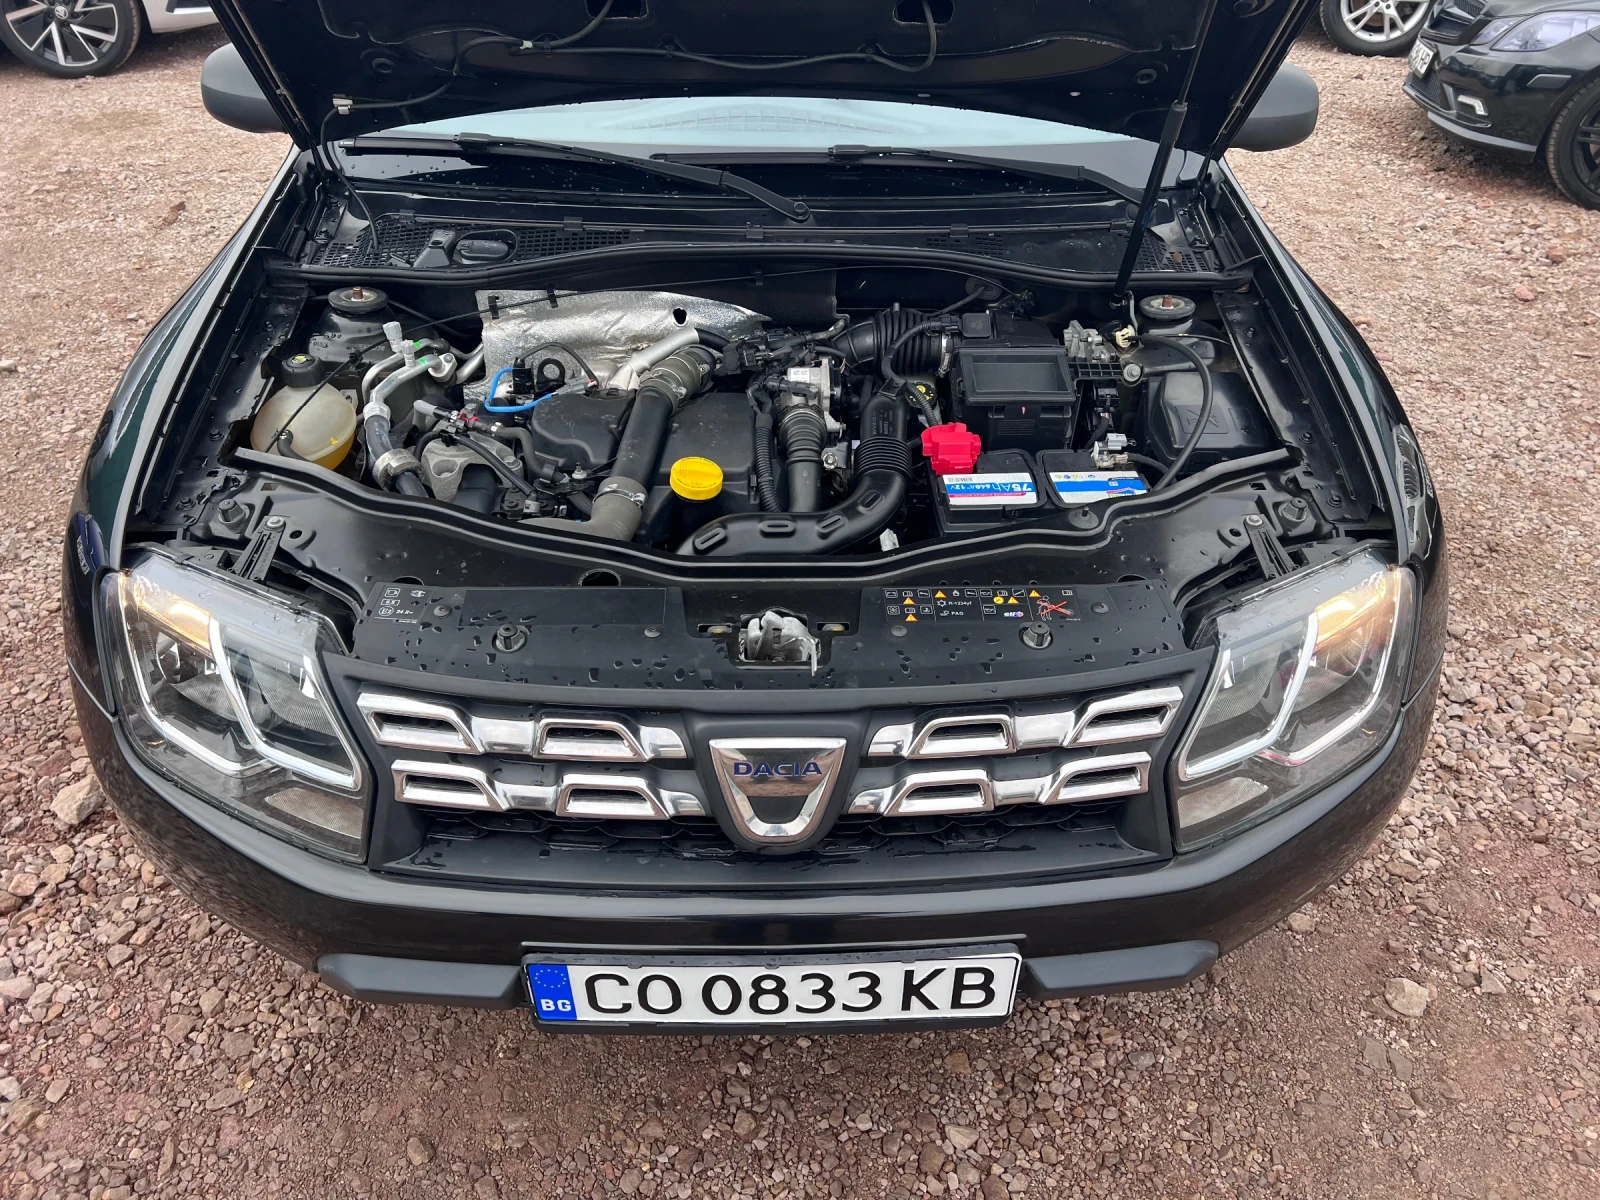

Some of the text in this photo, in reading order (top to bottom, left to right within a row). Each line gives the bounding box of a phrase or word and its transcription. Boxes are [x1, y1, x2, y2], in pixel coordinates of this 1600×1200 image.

[992, 482, 1033, 492] 75Ah
[733, 761, 823, 778] DACIA
[585, 966, 996, 1016] CO 0833 KB
[540, 998, 572, 1012] BG
